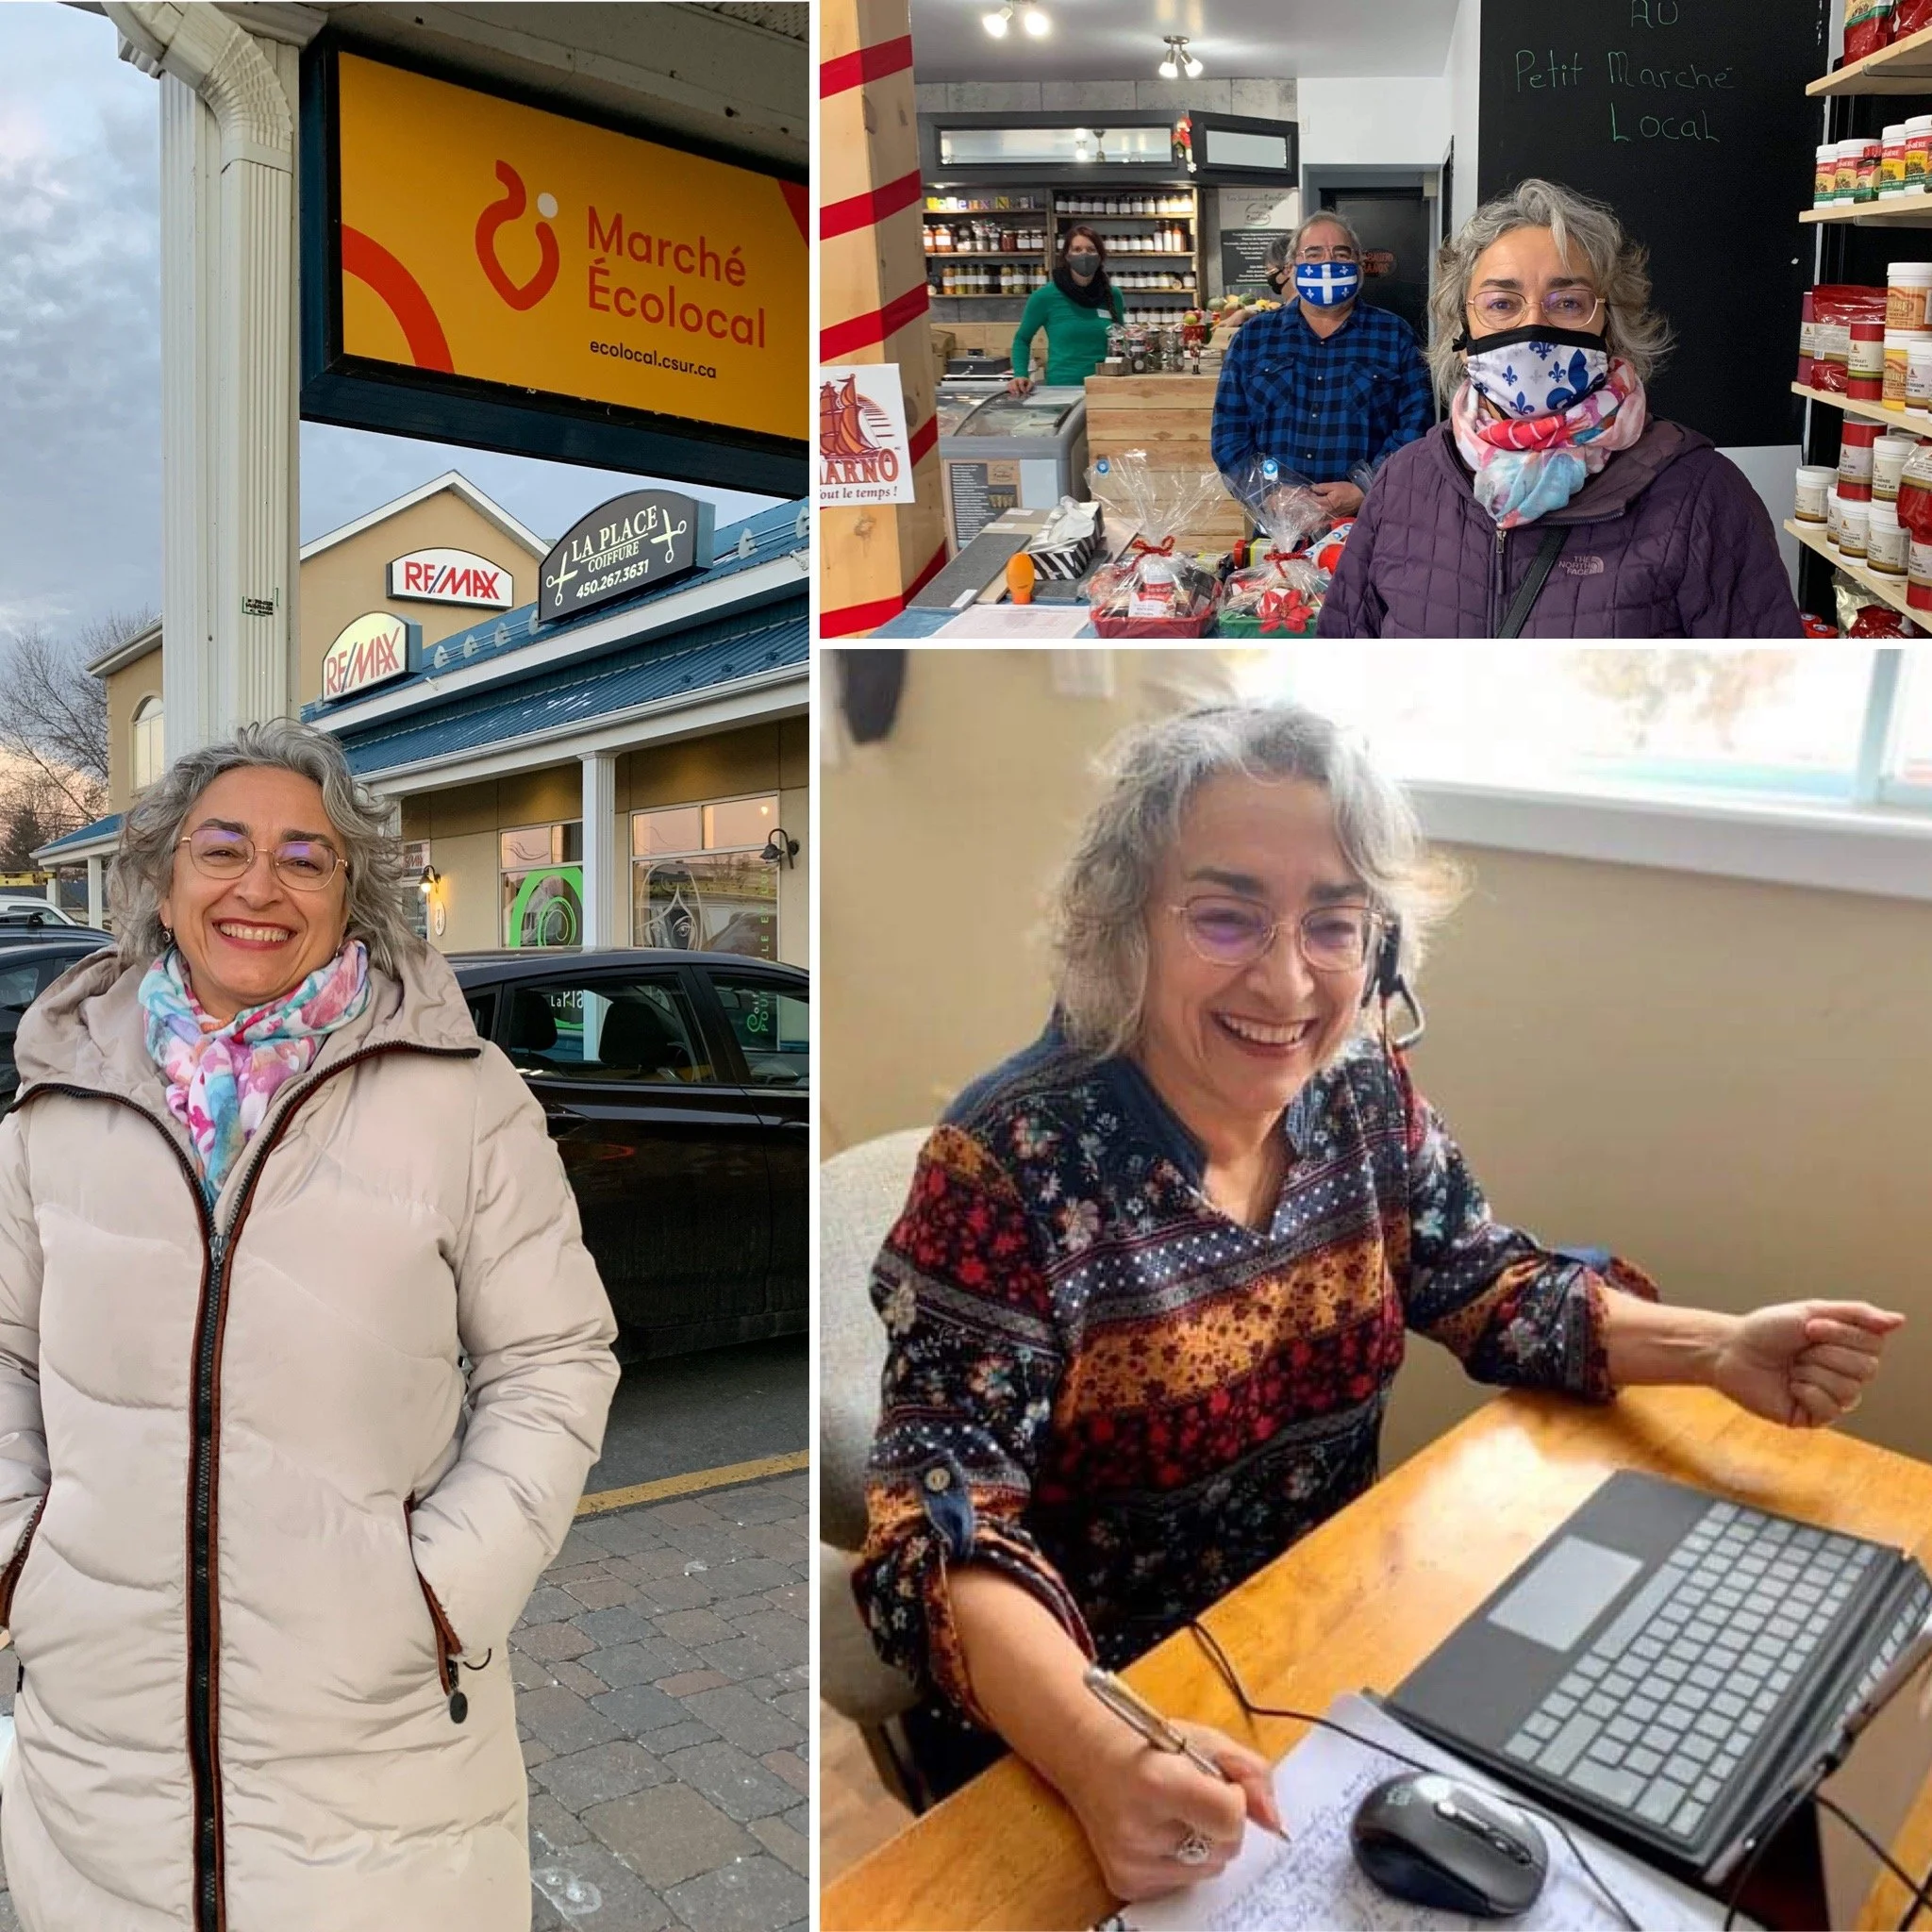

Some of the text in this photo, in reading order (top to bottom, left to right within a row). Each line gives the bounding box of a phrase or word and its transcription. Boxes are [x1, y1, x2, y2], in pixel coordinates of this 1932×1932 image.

[1631, 0, 1678, 28] AU
[1516, 50, 1583, 92] Petit
[588, 205, 747, 287] Marché
[589, 257, 765, 349] Écolocal
[590, 341, 717, 379] ecolocal.csur.ca
[820, 449, 898, 484] ARNO
[842, 487, 853, 499] le
[856, 489, 891, 501] temps
[572, 506, 658, 562] LA PLACE
[588, 541, 640, 573] COIFFURE
[405, 560, 500, 600] RE/MAX
[576, 558, 649, 599] 450.267.3631
[326, 625, 400, 696] RE/MAX
